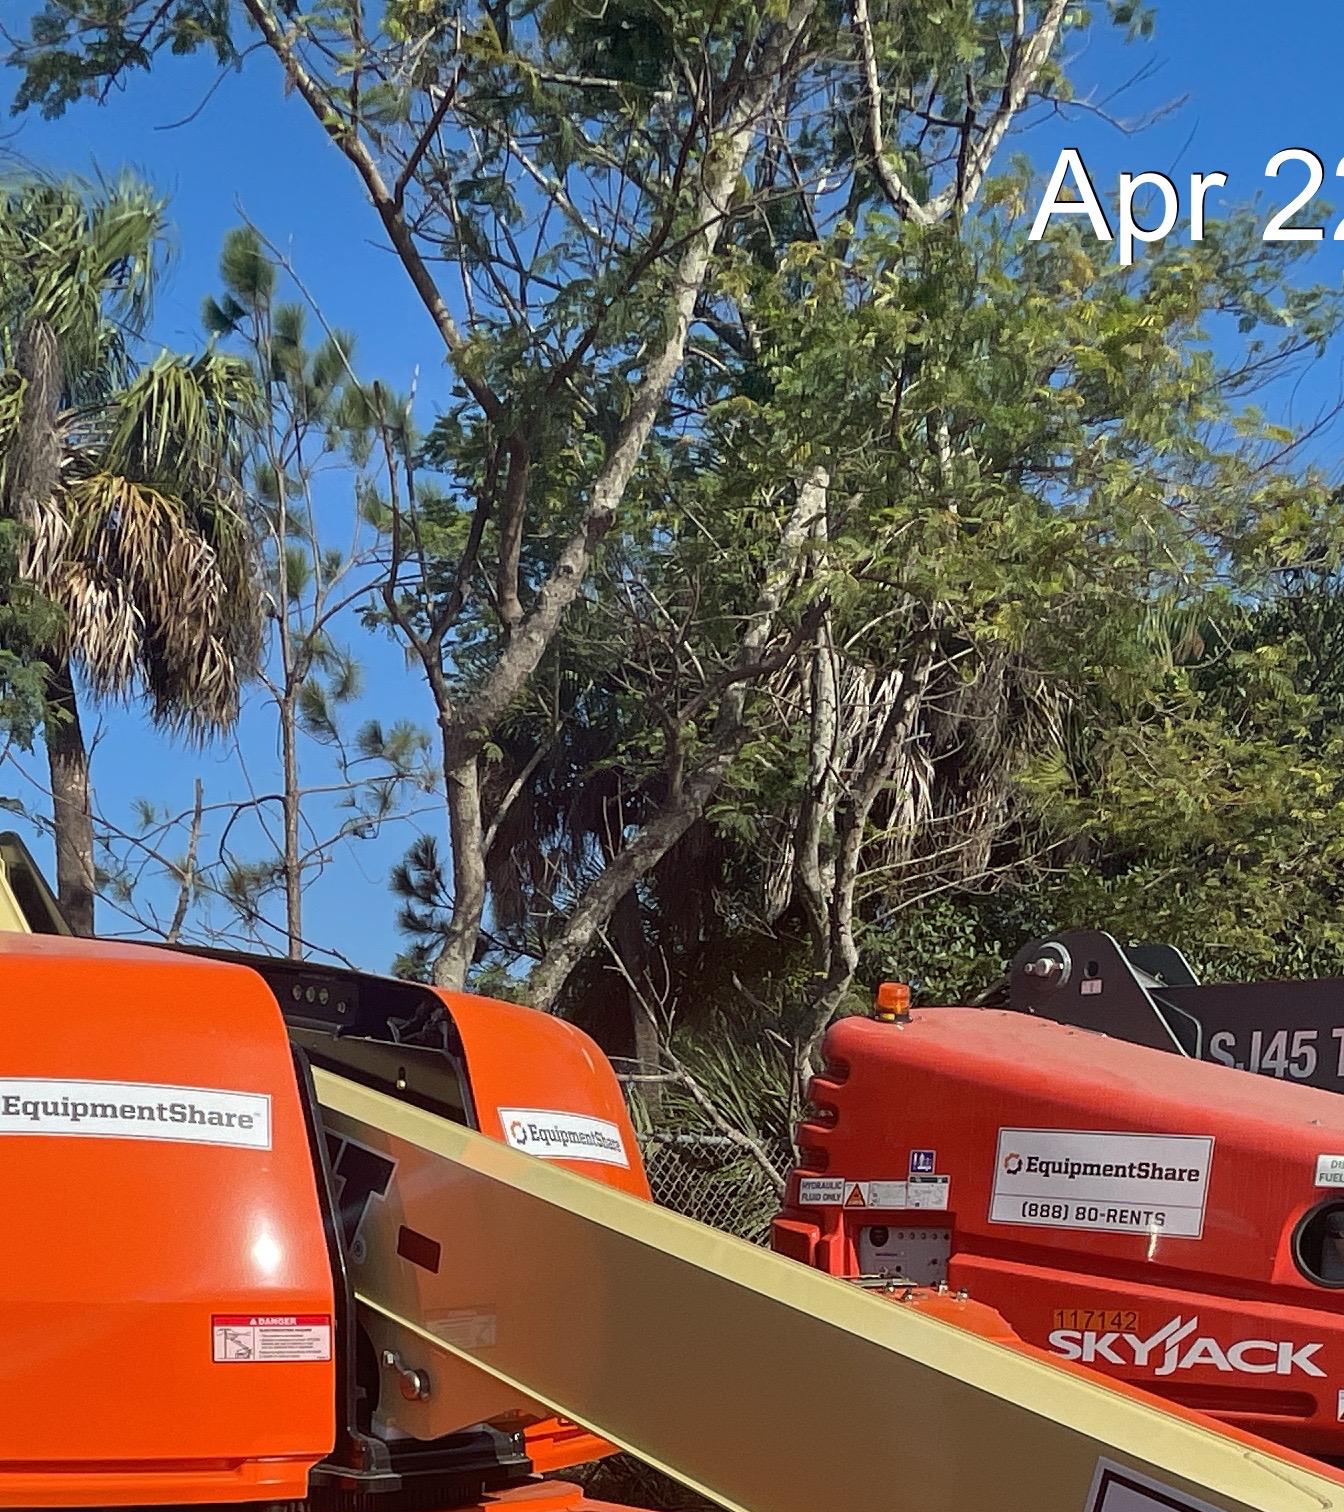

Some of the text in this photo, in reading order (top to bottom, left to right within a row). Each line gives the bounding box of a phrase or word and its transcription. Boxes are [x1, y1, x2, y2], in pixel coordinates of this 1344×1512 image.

[1209, 1029, 1318, 1079] SJ45
[0, 1094, 256, 1130] EquipmentShare
[527, 1122, 623, 1153] EquipmentShare
[1024, 1155, 1201, 1183] EquipmentShare
[1318, 1172, 1344, 1184] FUEL
[801, 1179, 843, 1191] HYDRAULIC
[1021, 1200, 1167, 1228] (888) 80-RENTS
[1056, 1310, 1138, 1332] 117142
[1047, 1314, 1329, 1379] SKYJACK
